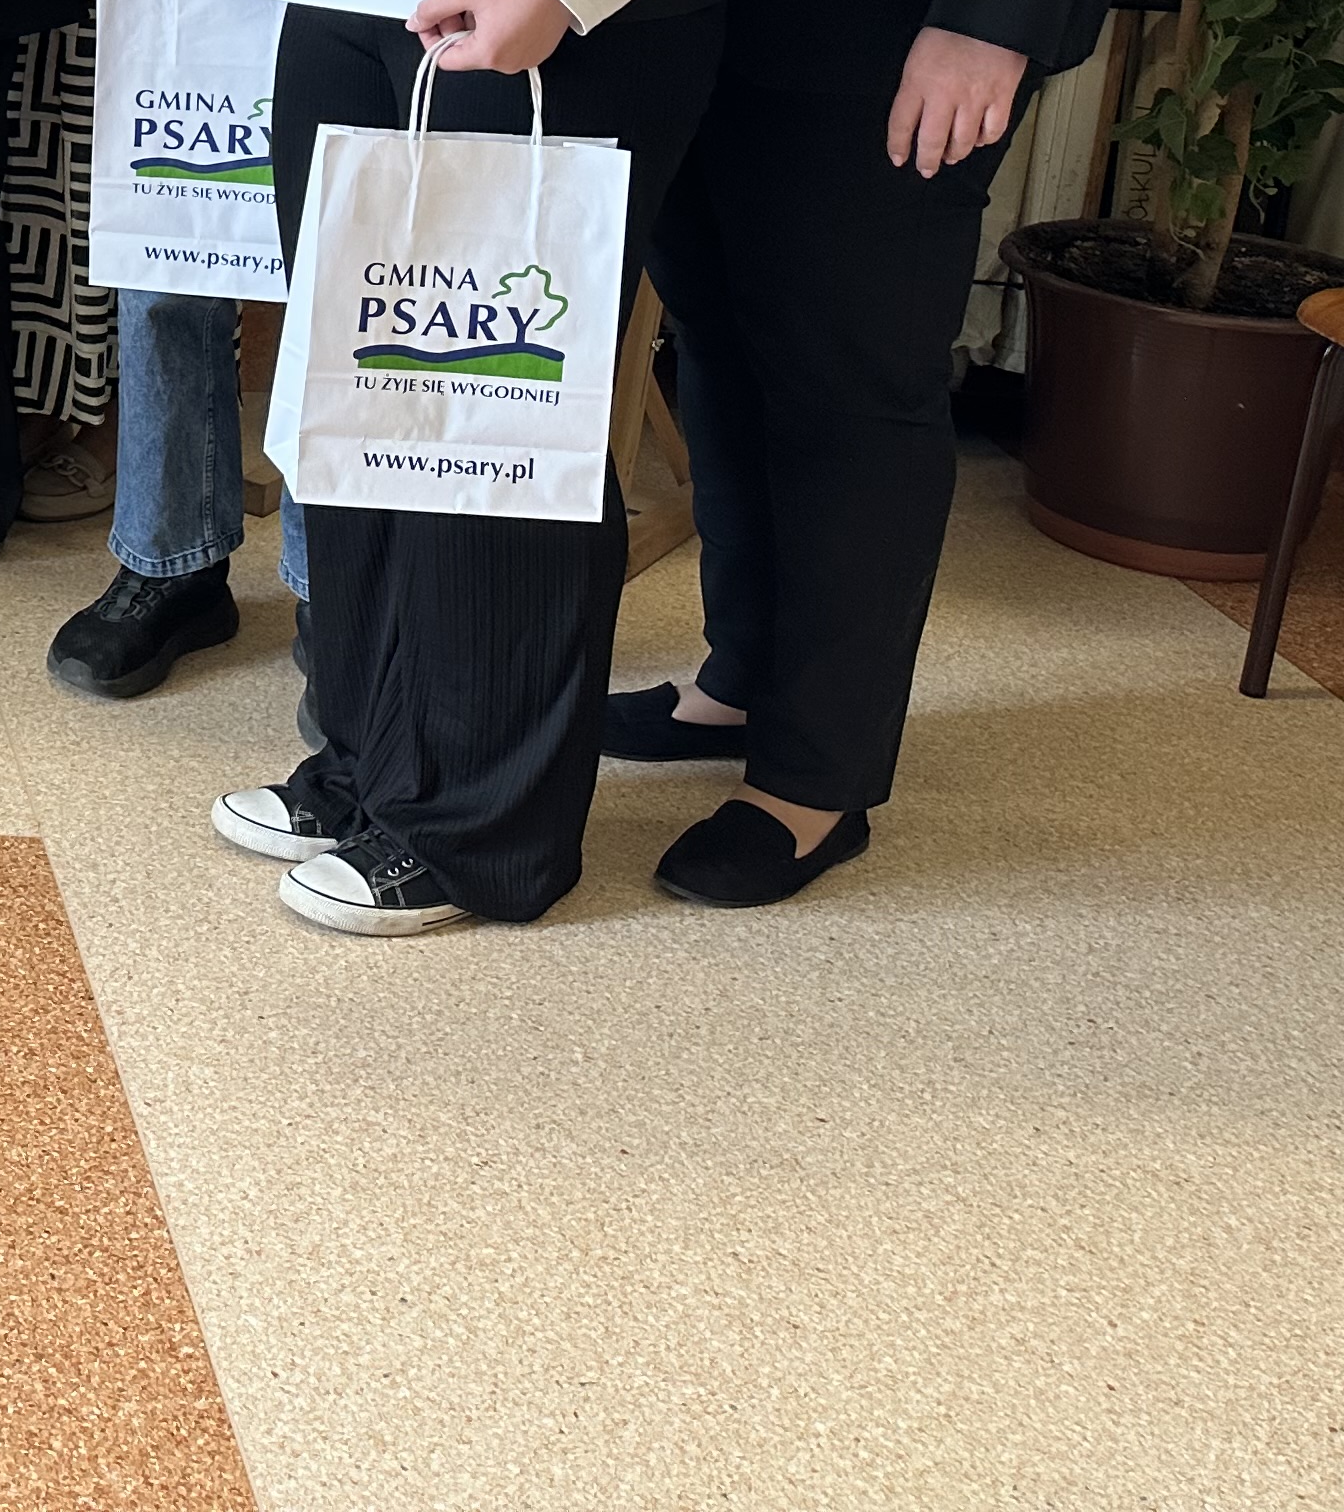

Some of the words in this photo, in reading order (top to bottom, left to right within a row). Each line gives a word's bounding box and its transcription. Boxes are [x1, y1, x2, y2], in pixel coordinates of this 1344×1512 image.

[135, 89, 236, 114] GMINA
[132, 182, 152, 195] TU
[155, 182, 188, 198] ŻYJE
[192, 186, 213, 201] SIĘ
[216, 189, 276, 205] WYGOD
[144, 246, 284, 274] www.psary.p
[363, 262, 479, 292] GMINA
[358, 296, 541, 344] PSARY
[354, 376, 377, 390] TU
[382, 373, 417, 393] ŻYJE
[421, 379, 445, 396] SIĘ
[450, 381, 560, 406] WYGODNIEJ
[363, 451, 534, 484] www.psary.pl
